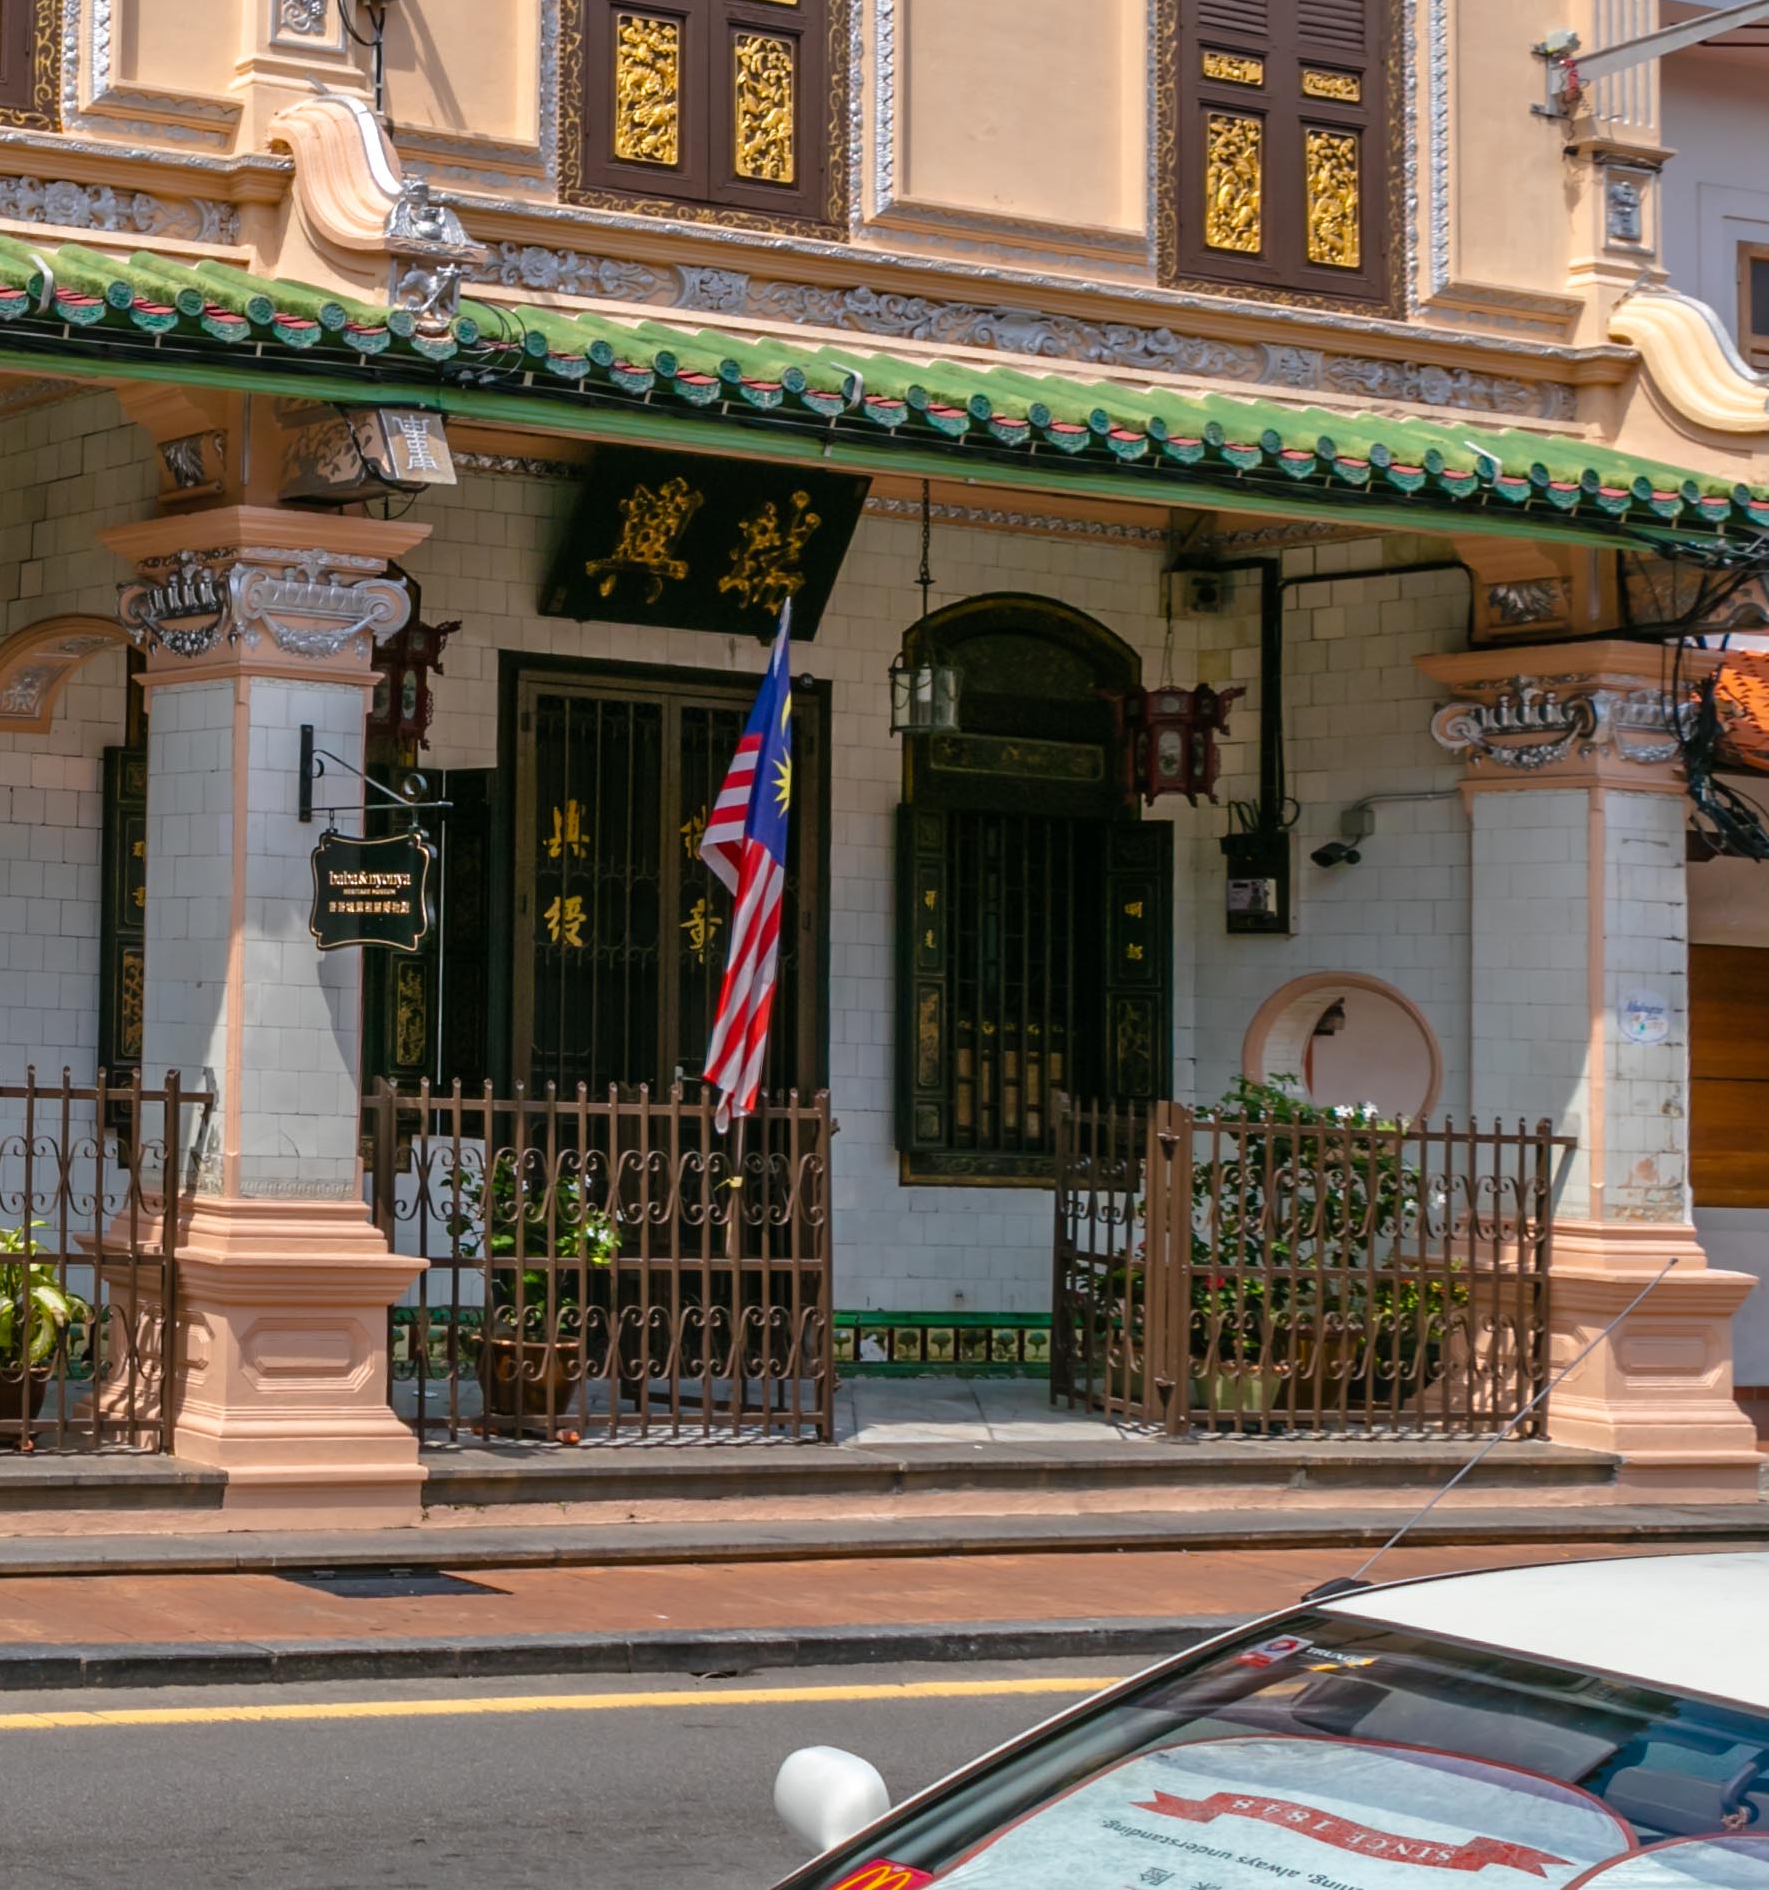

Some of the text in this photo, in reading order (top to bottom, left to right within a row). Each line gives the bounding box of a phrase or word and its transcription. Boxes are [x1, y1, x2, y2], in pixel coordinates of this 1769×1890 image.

[1101, 1819, 1234, 1861] understanding.
[1229, 1798, 1453, 1862] SINCE 1848
[1236, 1854, 1304, 1881] always
